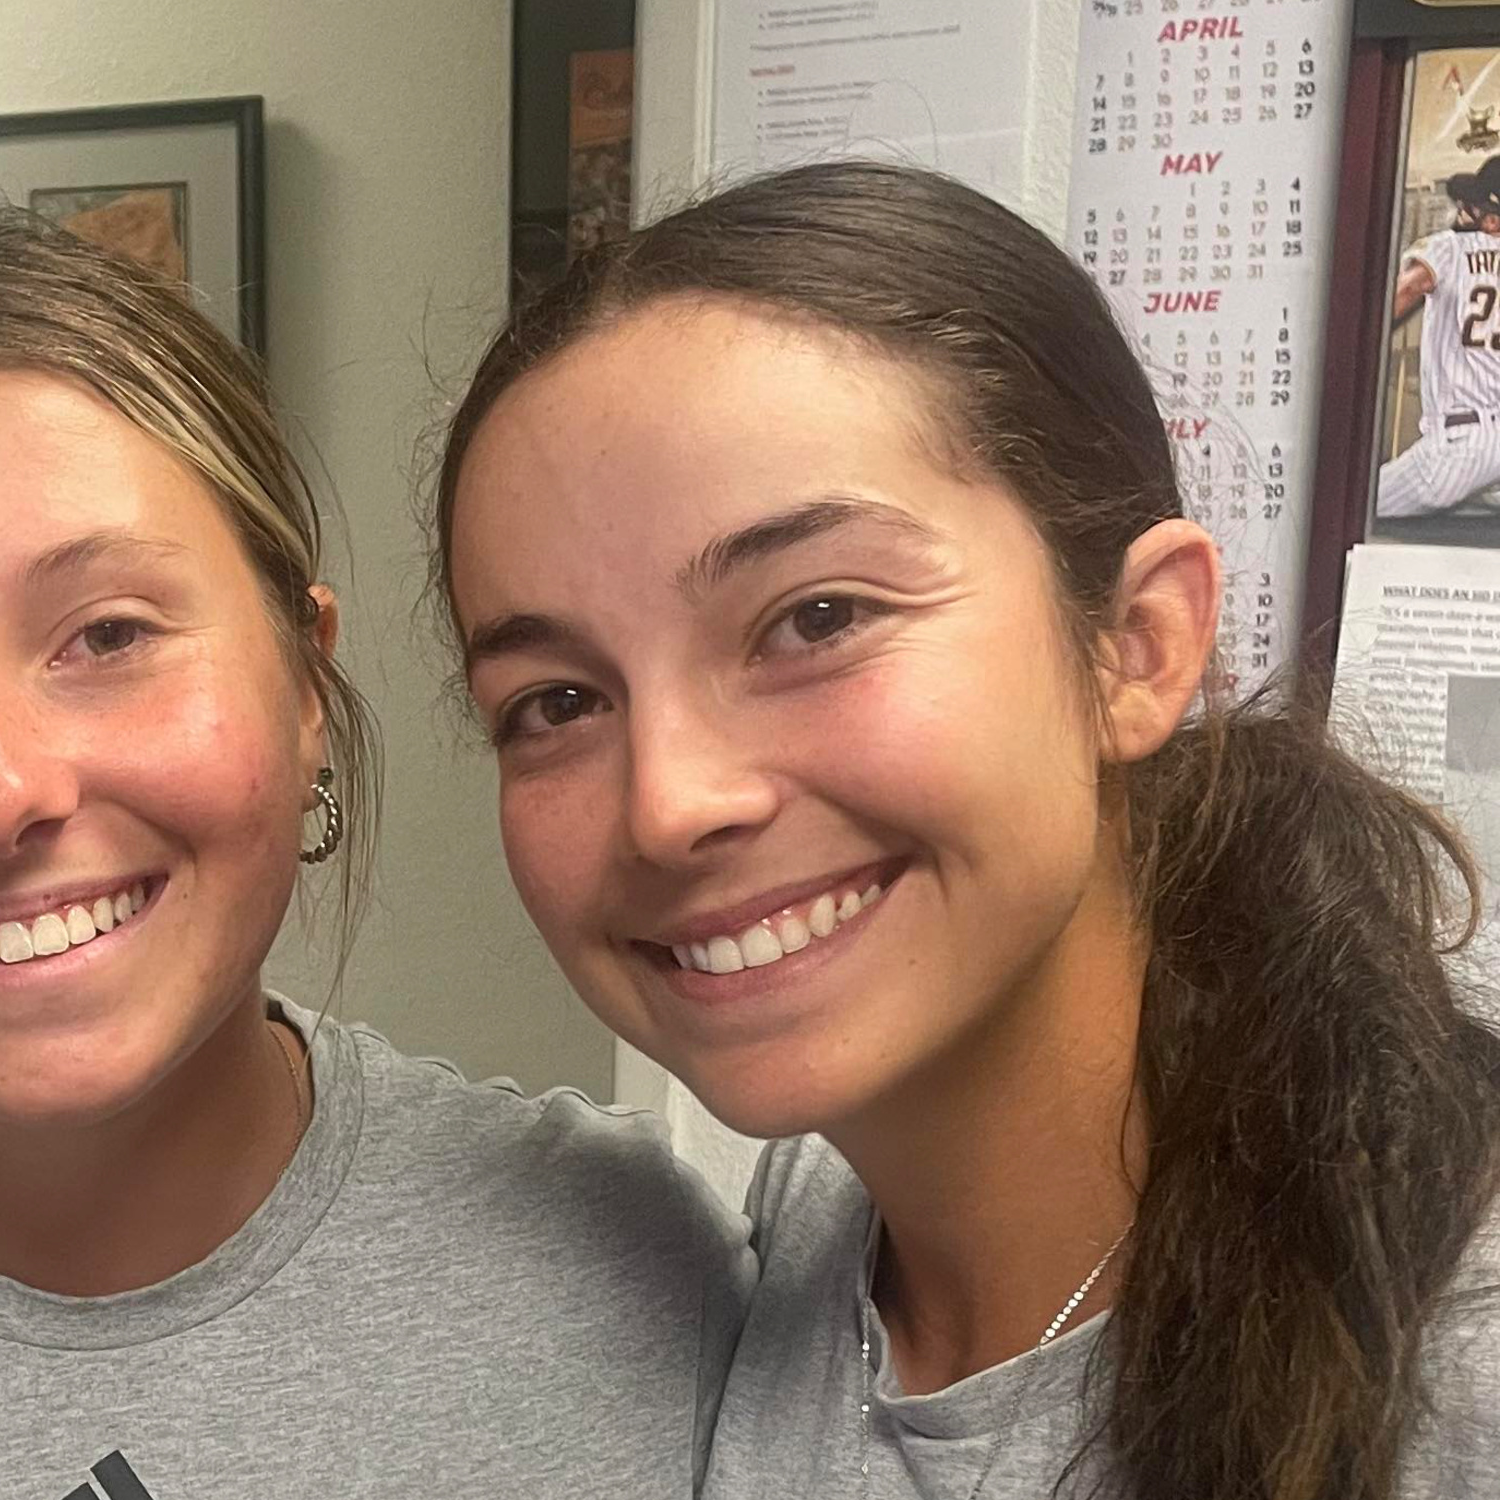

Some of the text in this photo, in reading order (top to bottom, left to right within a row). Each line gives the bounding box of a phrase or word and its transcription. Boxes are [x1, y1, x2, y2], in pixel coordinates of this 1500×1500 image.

[1157, 16, 1243, 43] APRIL
[1160, 151, 1222, 176] MAY
[1143, 290, 1221, 314] JUNE
[1461, 284, 1500, 348] 2
[1164, 417, 1211, 439] LY
[1383, 586, 1417, 598] WHAT
[1452, 589, 1469, 601] AN
